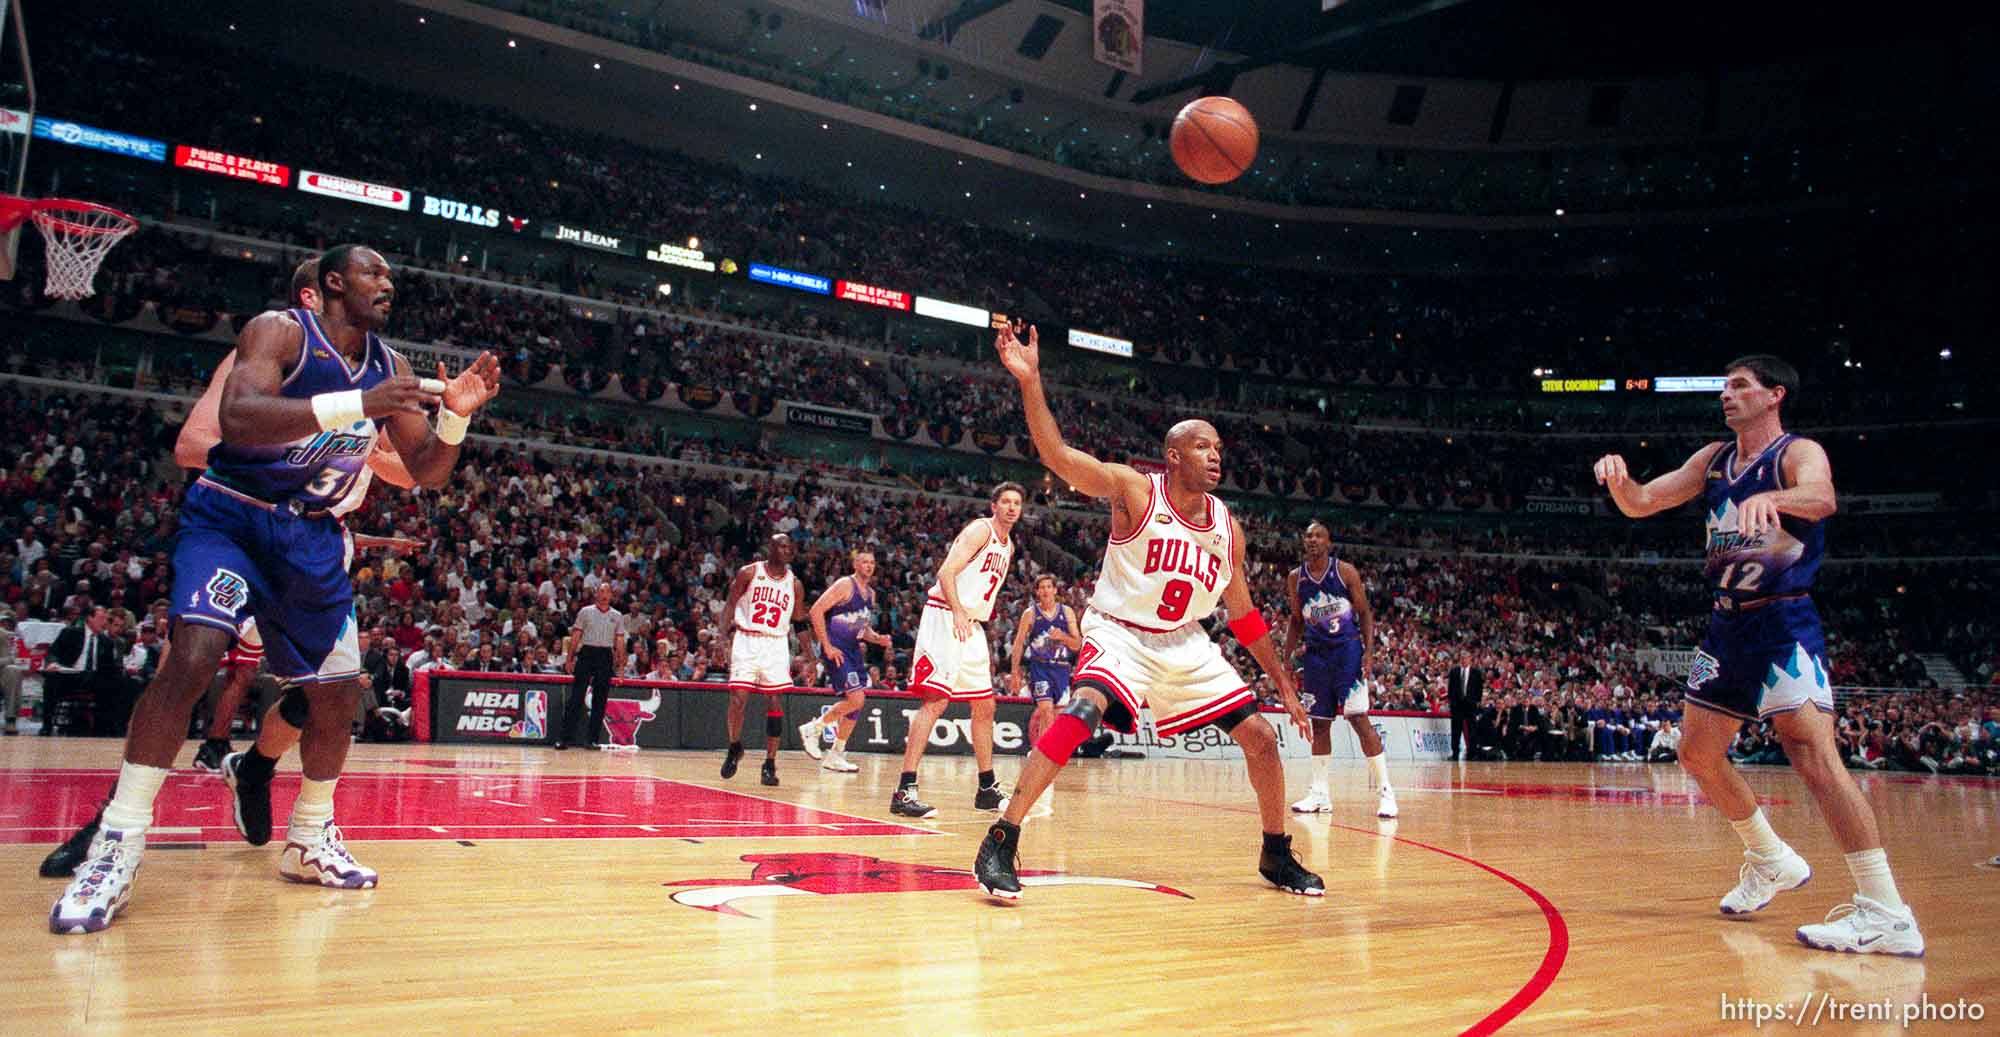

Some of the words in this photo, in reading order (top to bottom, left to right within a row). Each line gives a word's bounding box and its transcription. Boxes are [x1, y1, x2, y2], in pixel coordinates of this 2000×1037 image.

[423, 195, 500, 228] BULLS
[556, 225, 580, 241] JIM
[582, 229, 619, 248] BEAM
[1144, 538, 1221, 592] BULLS
[1718, 563, 1765, 590] 12
[752, 586, 790, 611] BULLS
[983, 575, 998, 602] 7
[1156, 579, 1194, 622] 9
[752, 603, 781, 628] 23
[464, 692, 520, 709] NBA
[456, 715, 512, 732] NBC
[867, 708, 889, 744] i
